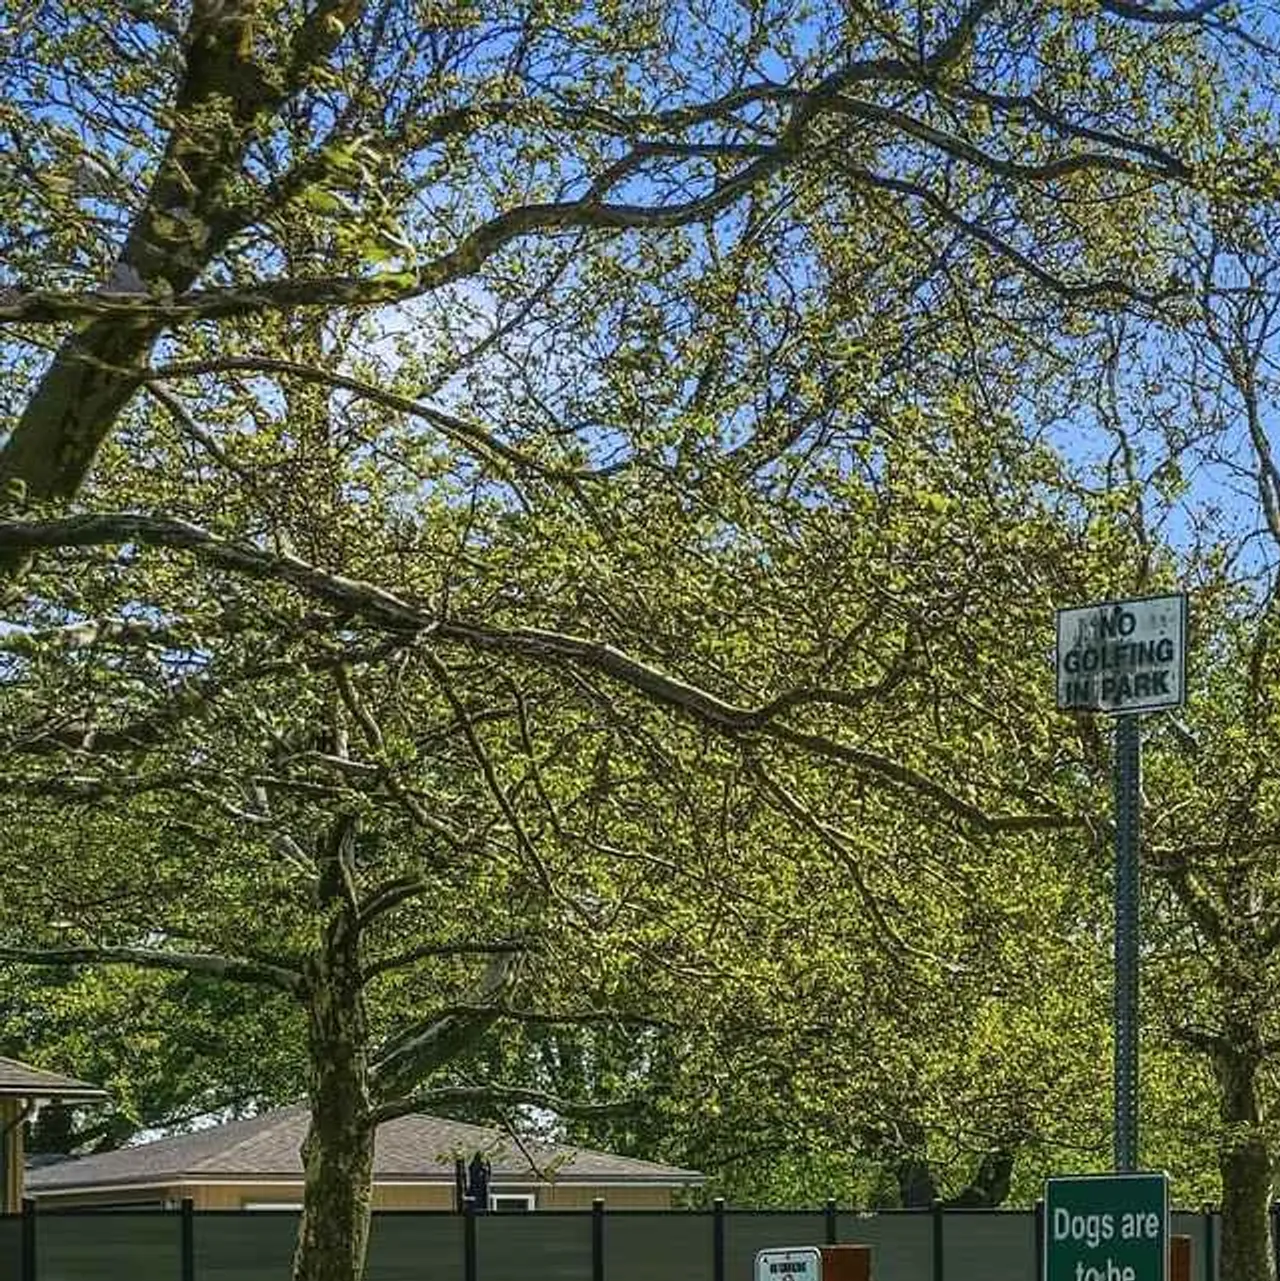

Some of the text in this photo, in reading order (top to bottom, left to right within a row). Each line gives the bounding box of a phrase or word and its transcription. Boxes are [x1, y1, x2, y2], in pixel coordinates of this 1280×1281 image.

[1099, 609, 1137, 640] NO
[1063, 638, 1174, 674] GOLFING
[1065, 669, 1170, 702] IN PARK
[1053, 1207, 1160, 1248] Dogs are
